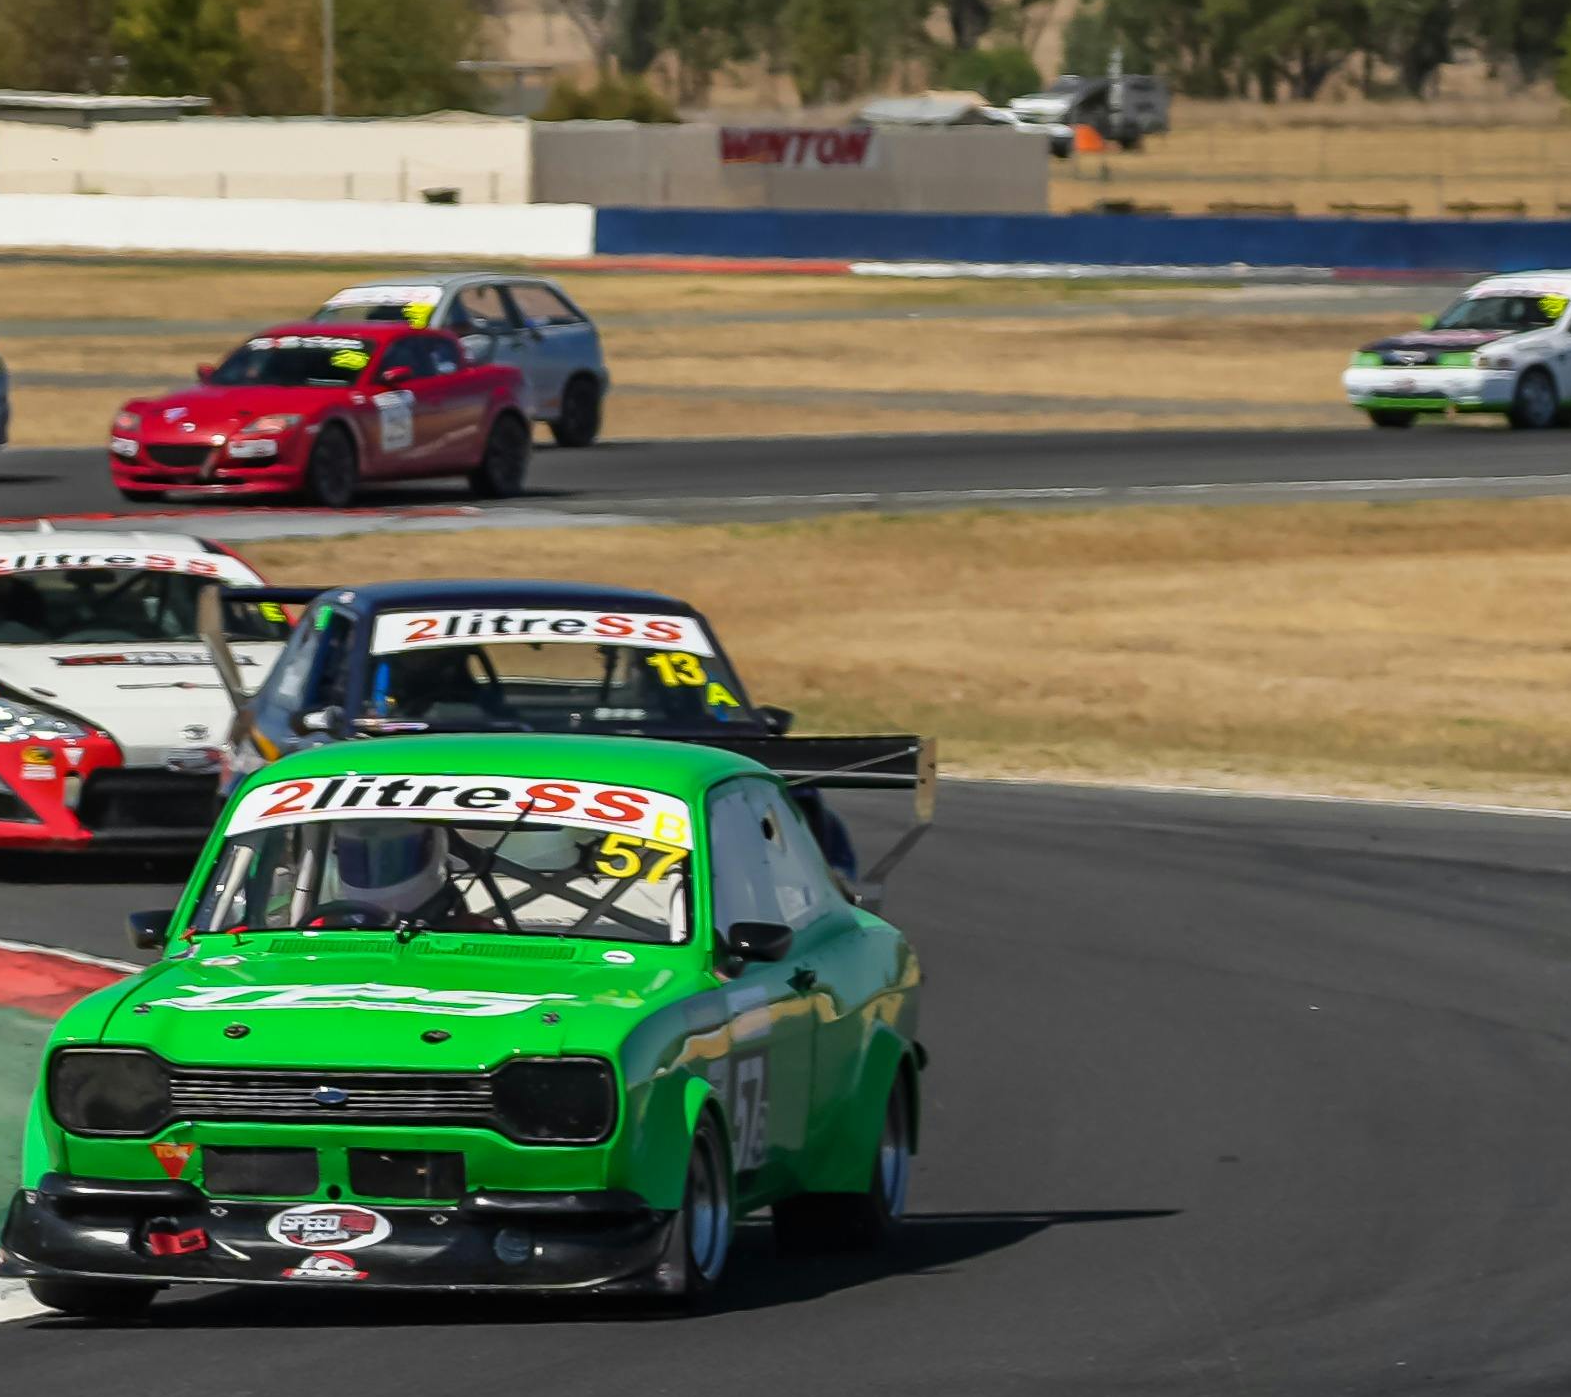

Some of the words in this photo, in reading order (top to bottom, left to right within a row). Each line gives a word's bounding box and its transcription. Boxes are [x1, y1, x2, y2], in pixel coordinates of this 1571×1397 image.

[720, 129, 872, 164] WINTON
[403, 613, 683, 643] 2litreSS
[646, 652, 707, 687] 13
[706, 682, 740, 708] A
[258, 776, 651, 823] 2litreSS
[653, 812, 686, 843] B
[595, 834, 689, 884] 57
